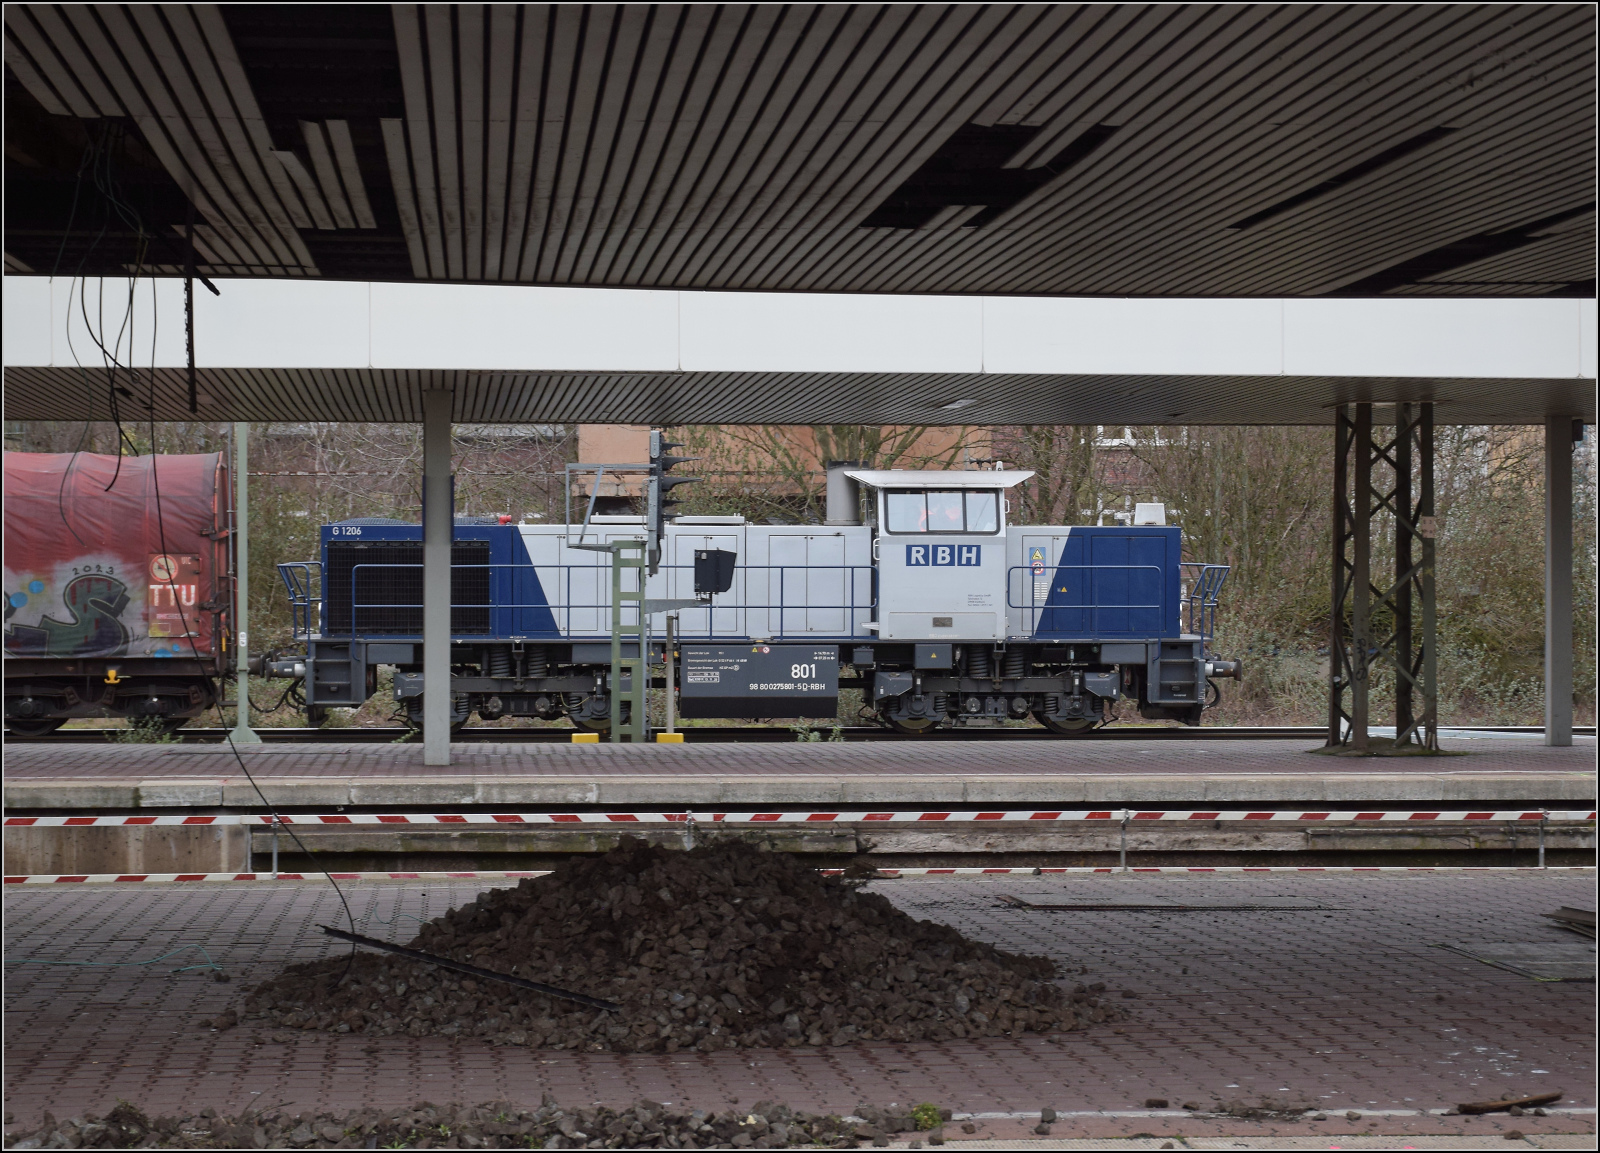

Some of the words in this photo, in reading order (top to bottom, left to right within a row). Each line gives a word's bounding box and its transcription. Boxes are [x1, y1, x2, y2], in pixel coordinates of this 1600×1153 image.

[332, 526, 339, 536] G
[341, 526, 362, 536] 1206
[910, 546, 977, 565] RBH
[72, 564, 115, 576] 2023
[149, 584, 196, 607] TTU
[791, 663, 816, 679] 801
